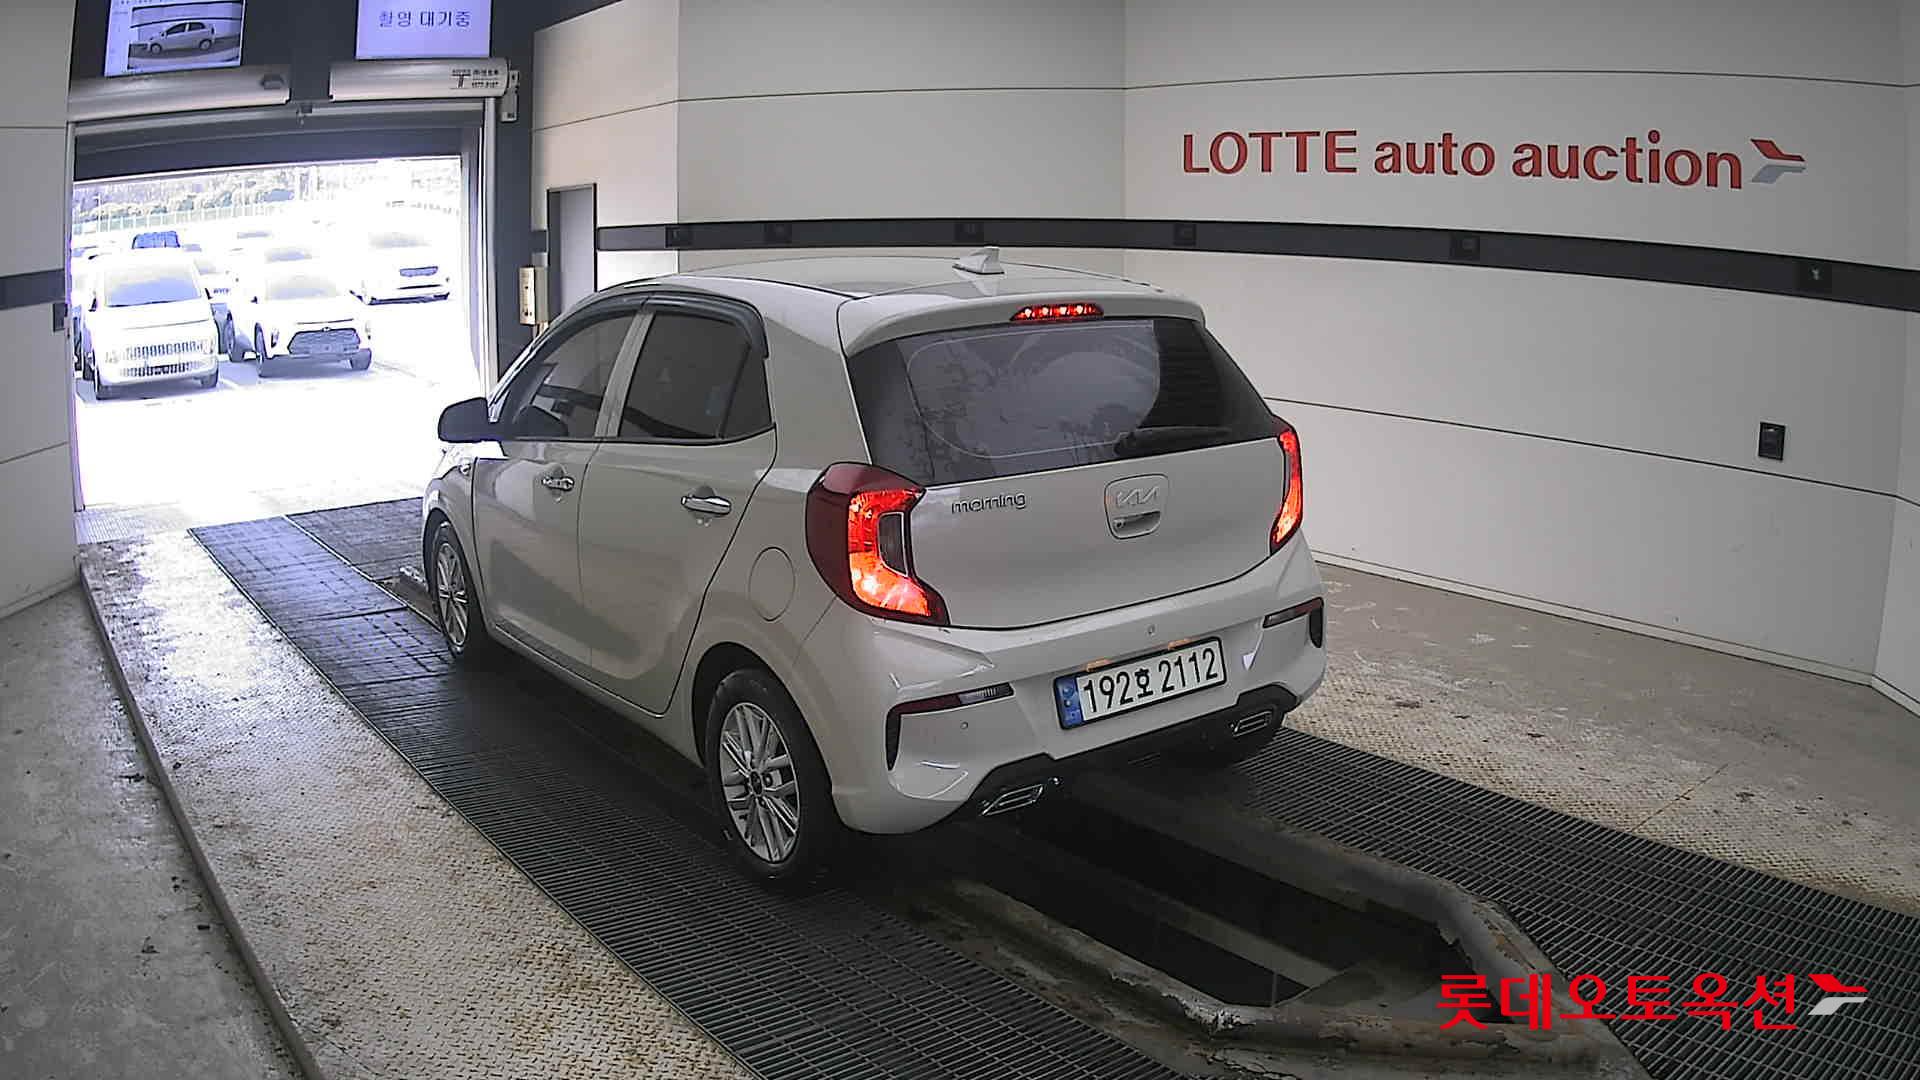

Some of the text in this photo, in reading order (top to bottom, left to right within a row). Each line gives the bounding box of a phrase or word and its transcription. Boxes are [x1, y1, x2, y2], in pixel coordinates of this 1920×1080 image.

[420, 11, 470, 27] 대기중
[1183, 130, 1743, 189] LOTTE auto auction
[951, 493, 1026, 514] morning
[1083, 647, 1218, 713] 192호 2112
